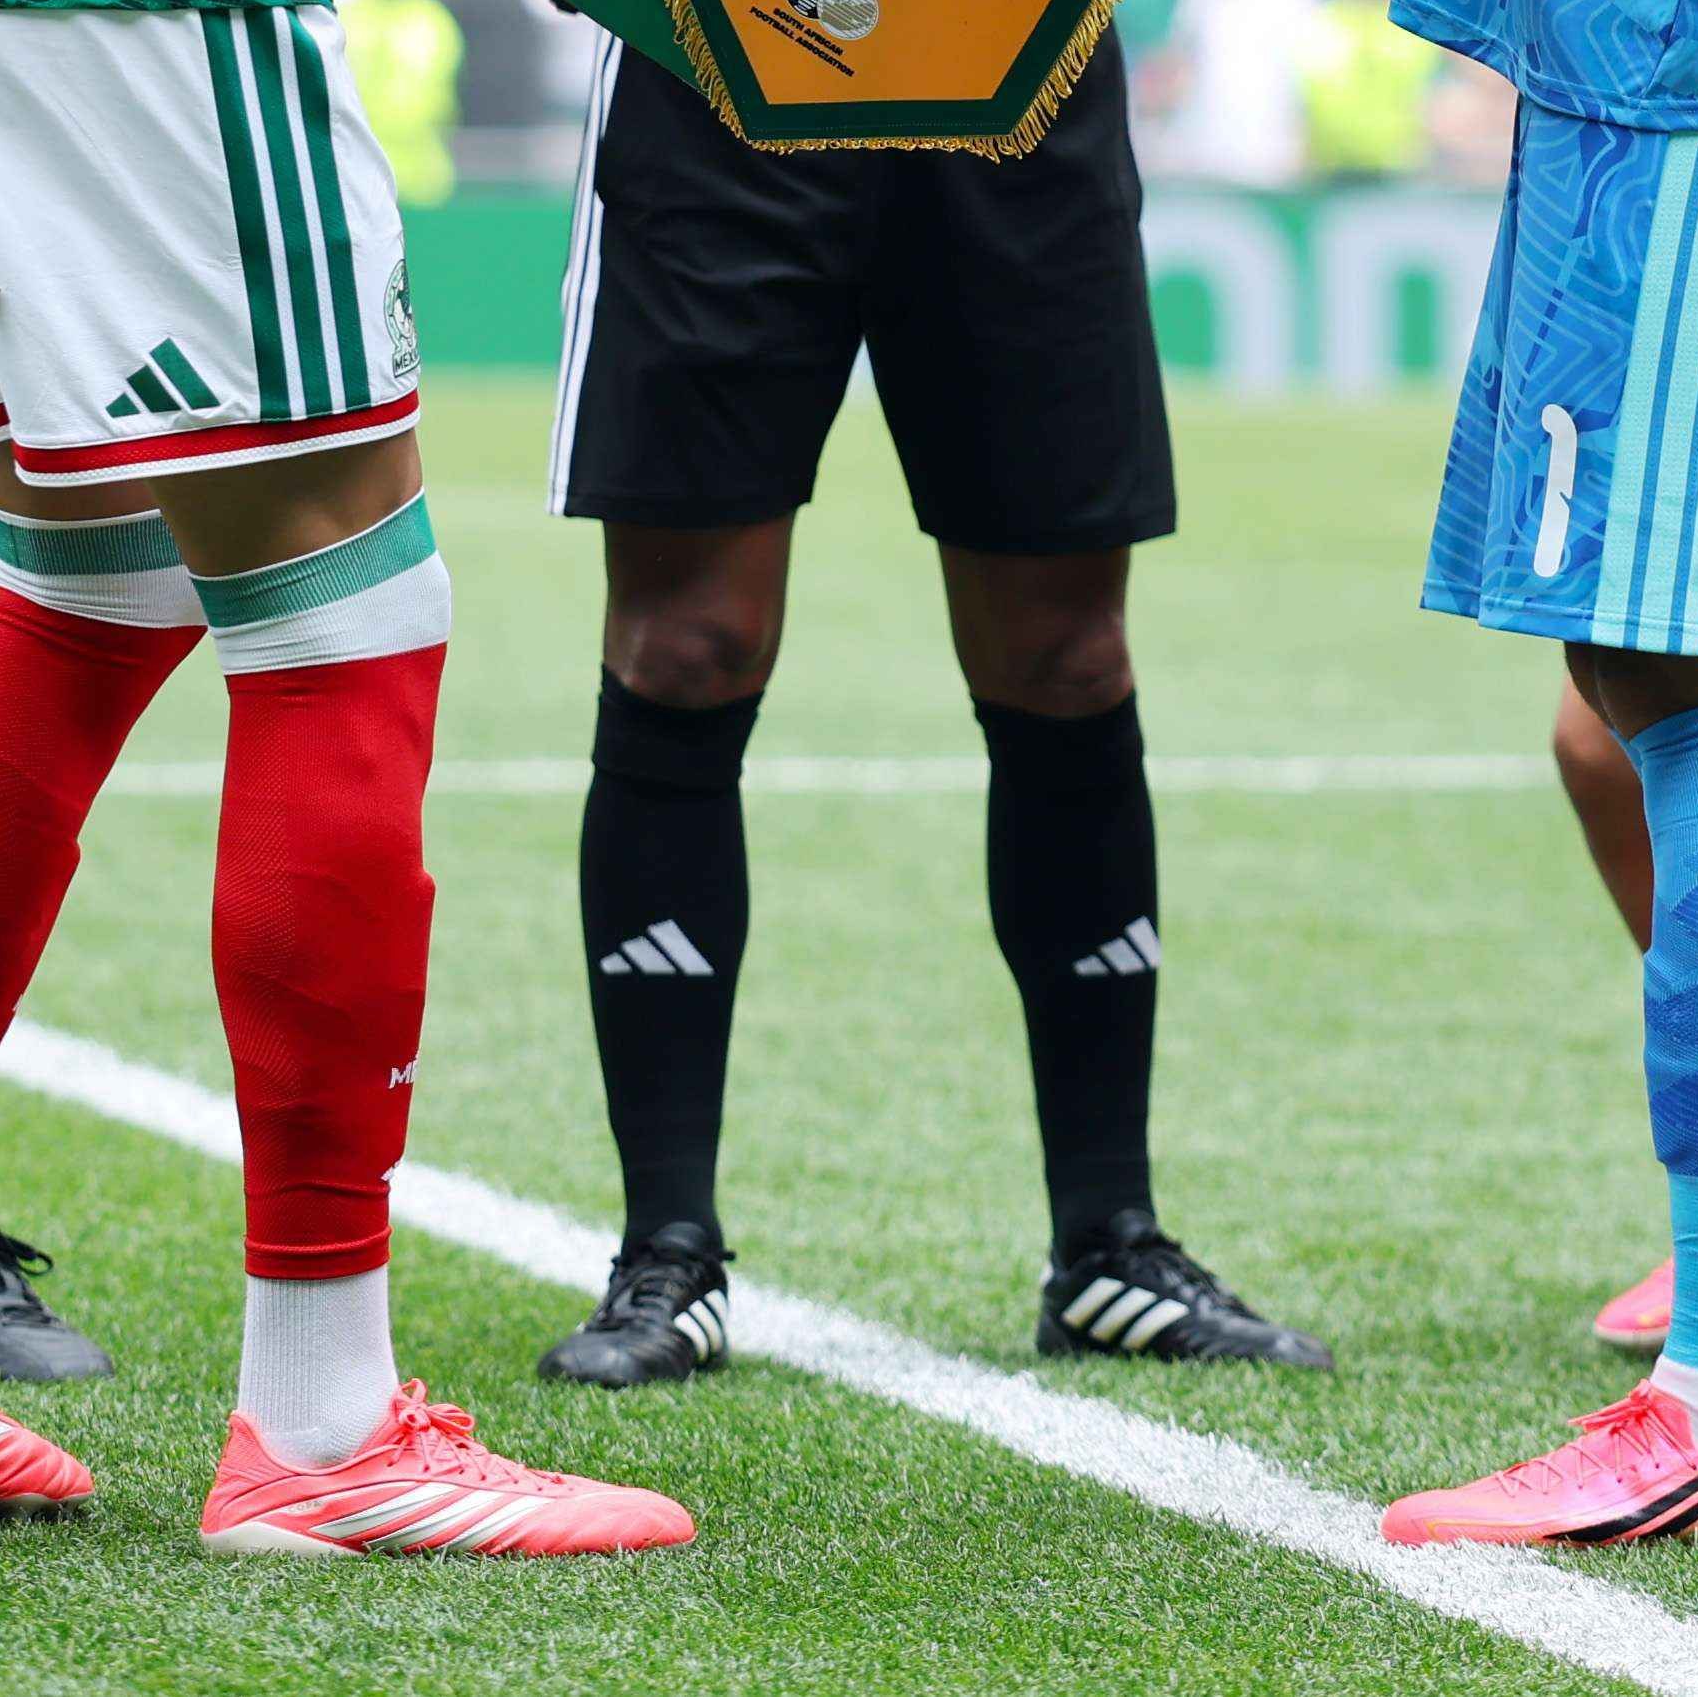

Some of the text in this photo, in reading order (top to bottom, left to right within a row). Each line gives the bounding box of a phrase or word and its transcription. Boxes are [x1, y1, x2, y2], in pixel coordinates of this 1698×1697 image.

[748, 6, 855, 77] FOOTBALL ASSOCIATION
[773, 7, 844, 56] SOUTH AFRICAN
[1537, 403, 1578, 578] 1
